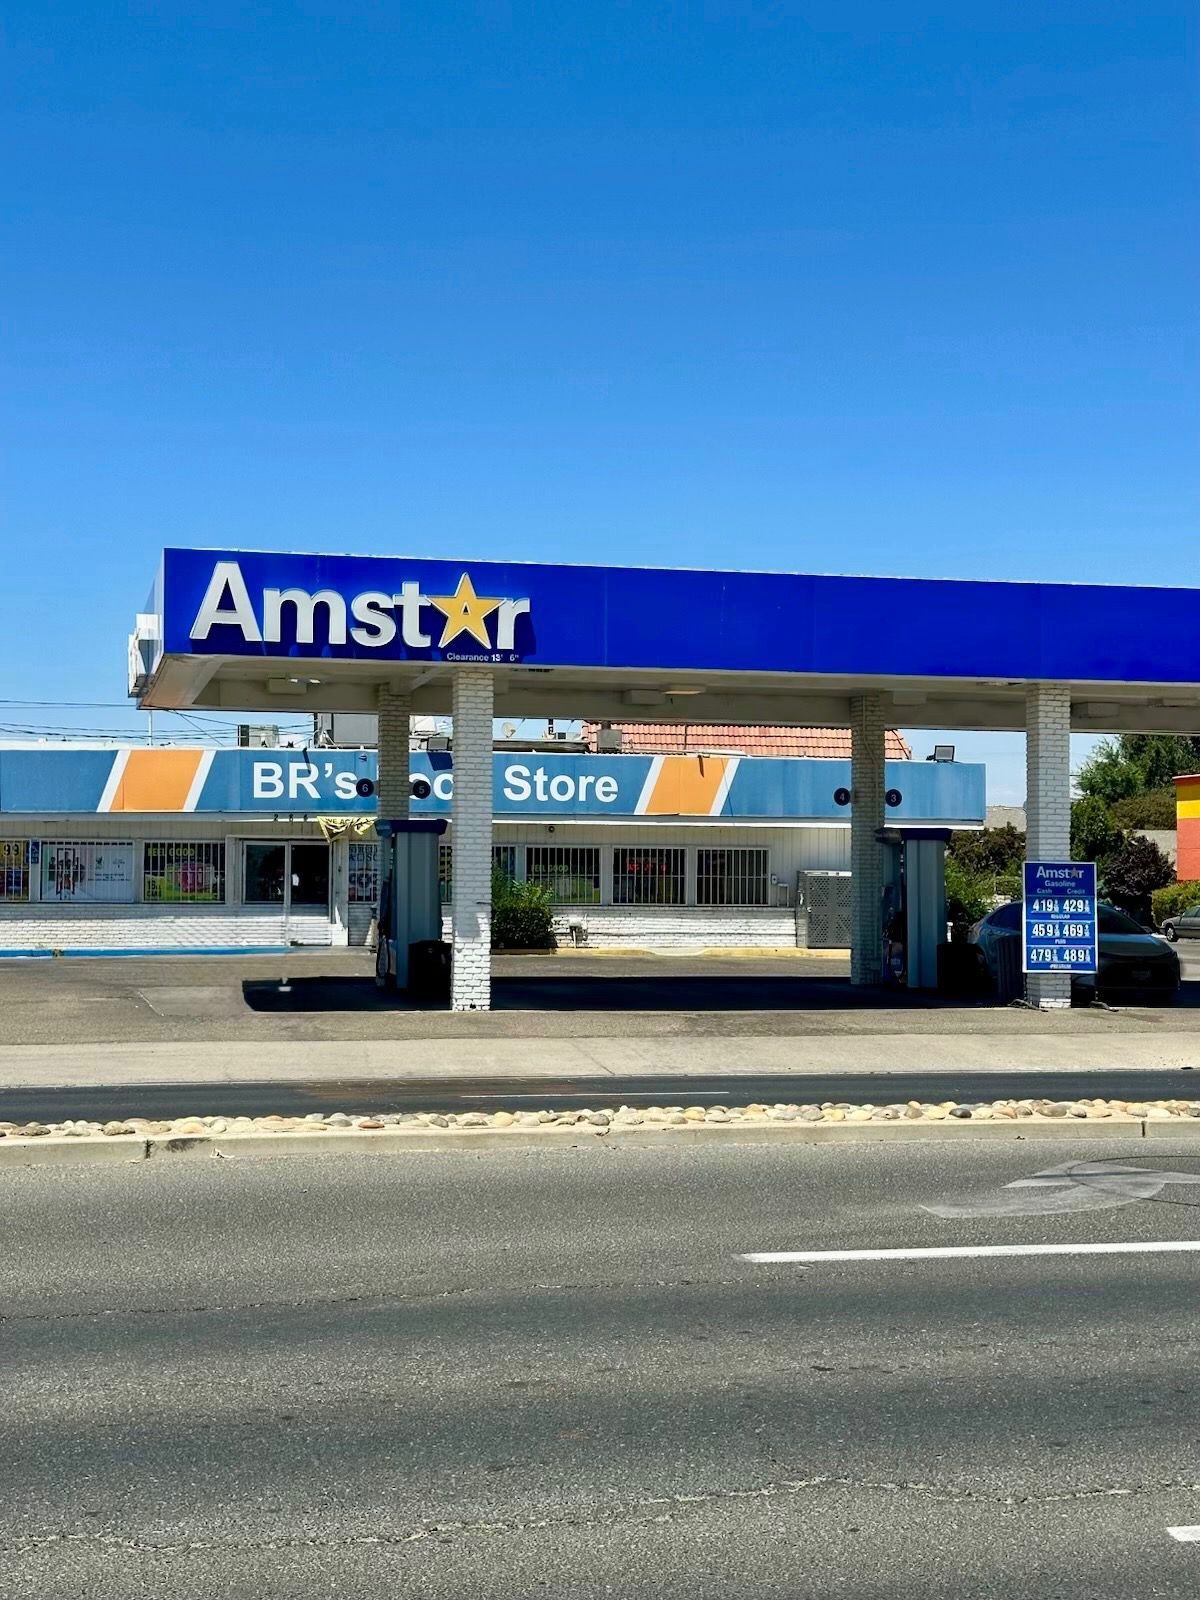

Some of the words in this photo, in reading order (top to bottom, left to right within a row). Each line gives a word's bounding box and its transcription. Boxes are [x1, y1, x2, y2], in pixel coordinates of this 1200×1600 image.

[446, 652, 489, 662] Clearance
[253, 762, 358, 799] BR's
[503, 764, 619, 802] Store
